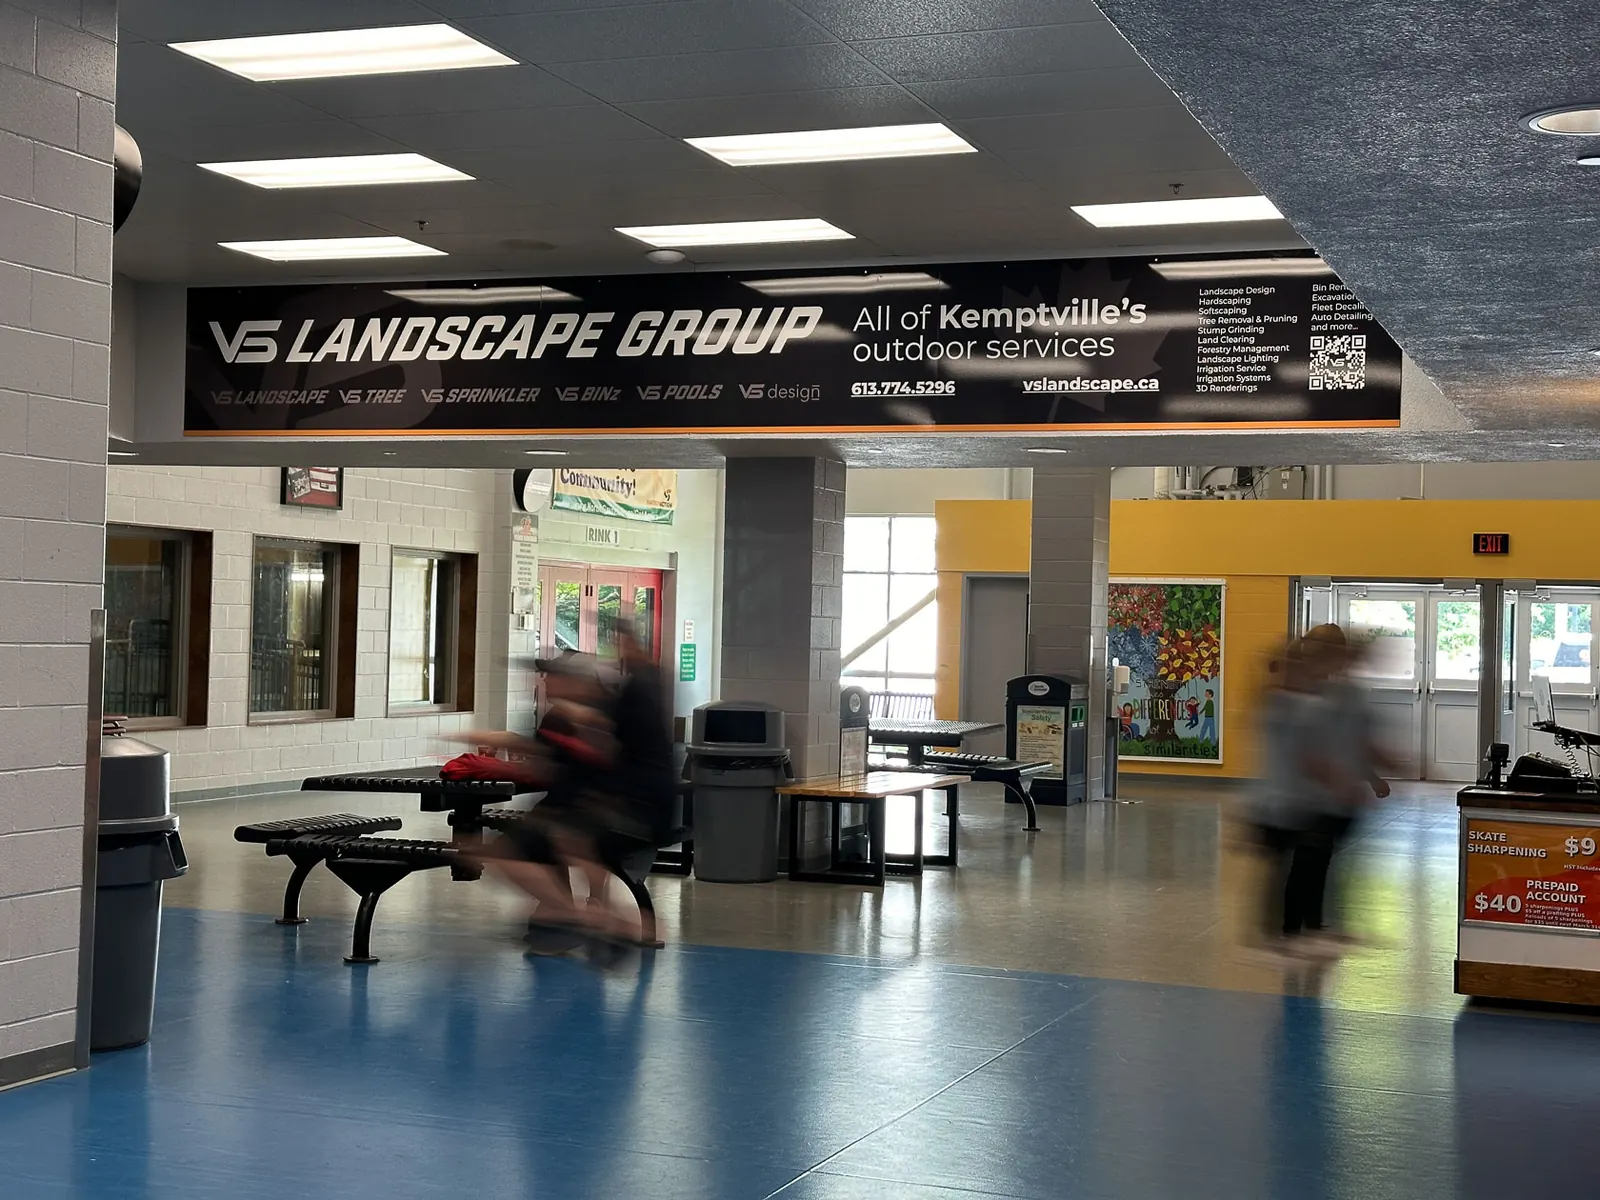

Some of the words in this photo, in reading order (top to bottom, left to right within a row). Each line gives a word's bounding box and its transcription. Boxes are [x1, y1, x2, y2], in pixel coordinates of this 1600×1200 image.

[1199, 287, 1244, 297] Landscape
[1246, 286, 1275, 296] Design
[1312, 284, 1327, 292] Bin
[1199, 297, 1252, 307] Hardscaping
[1311, 303, 1333, 311] Fleet
[853, 305, 890, 331] All
[900, 304, 931, 330] of
[939, 297, 1147, 333] Kemptville's
[1199, 306, 1248, 316] Softscaping
[1311, 313, 1332, 321] Auto
[1334, 312, 1374, 321] Detailing
[1198, 317, 1217, 325] Tree
[1218, 315, 1254, 324] Removal
[1256, 315, 1262, 323] &
[1264, 314, 1298, 324] Pruning
[1198, 327, 1227, 336] Stump
[1228, 326, 1265, 336] Grinding
[1310, 323, 1328, 332] and
[285, 312, 615, 363] LANDSCAPE
[616, 306, 824, 357] GROUP
[1198, 336, 1218, 344] Land
[1220, 335, 1255, 345] Clearing
[853, 335, 977, 362] outdoor
[986, 332, 1115, 358] services
[1198, 346, 1231, 355] Forestry
[1233, 345, 1290, 354] Management
[1197, 355, 1242, 365] Landscape
[1244, 354, 1279, 364] Lighting
[1197, 365, 1235, 375] Irrigation
[1236, 364, 1267, 372] Service
[1023, 376, 1159, 393] vslandscape.ca
[1196, 375, 1234, 384] Irrigation
[1236, 374, 1271, 383] Systems
[851, 380, 955, 397] 613.774.5296
[1195, 384, 1208, 393] 3D
[1210, 383, 1258, 393] Renderings
[234, 389, 330, 405] LANDSCAPE
[364, 389, 407, 404] TREE
[445, 387, 541, 403] SPRINKLER
[662, 384, 723, 400] POOLS
[767, 384, 820, 402] design
[588, 526, 611, 543] RINK
[614, 530, 618, 543] 1
[1479, 535, 1503, 552] EXIT
[1133, 698, 1192, 721] DIFFERENCES
[1143, 742, 1217, 758] similarities
[1468, 831, 1507, 842] SKATE
[1467, 843, 1547, 858] SHARPENING
[1564, 836, 1596, 857] $9
[1526, 880, 1579, 892] PREPAID
[1475, 892, 1522, 913] $40
[1526, 891, 1587, 904] ACCOUNT
